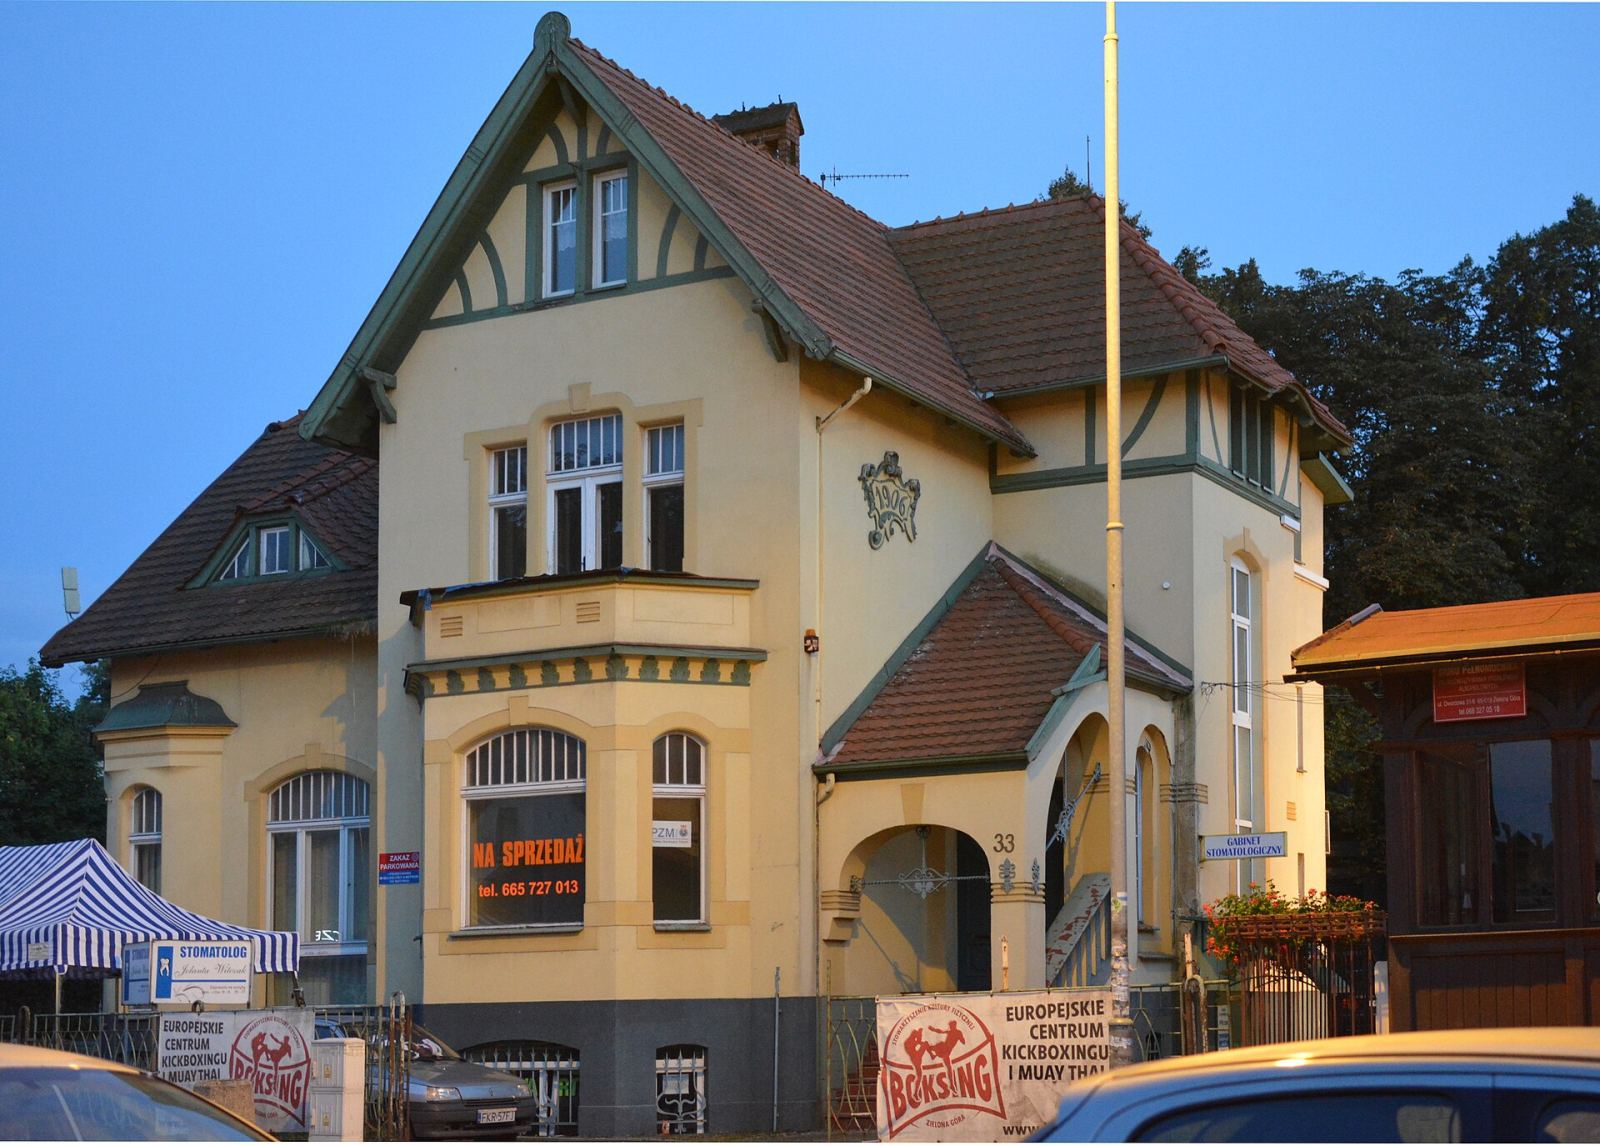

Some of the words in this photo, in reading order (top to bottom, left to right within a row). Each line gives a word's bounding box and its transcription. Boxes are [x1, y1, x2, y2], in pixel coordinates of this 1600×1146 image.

[876, 485, 908, 517] 1906
[993, 833, 1015, 853] 33
[1227, 835, 1261, 847] GABINET
[390, 854, 410, 862] ZAKAZ
[473, 842, 496, 868] NA
[502, 833, 584, 867] SPRZEDAŻ
[1206, 845, 1281, 858] STOMATOLOGICZNY
[380, 862, 419, 870] PARKOWANIA
[479, 883, 498, 897] tel.
[502, 882, 525, 896] 665
[529, 881, 552, 895] 727
[555, 880, 578, 894] 013
[180, 946, 247, 958] STOMATOLOG
[1005, 999, 1104, 1021] EUROPEJSKIE
[163, 1020, 224, 1035] EUROPEJSKIE
[1029, 1022, 1104, 1040] CENTRUM
[165, 1038, 210, 1050] CENTRUM
[161, 1052, 227, 1067] KICKBOXINGU
[1002, 1044, 1109, 1061] KICKBOXINGU
[168, 1070, 197, 1082] MUAY
[198, 1068, 221, 1080] THAI
[1018, 1065, 1064, 1080] MUAY
[890, 1053, 992, 1121] BOKSING
[926, 1119, 950, 1128] ZIELONA
[950, 1114, 966, 1126] GÓRA
